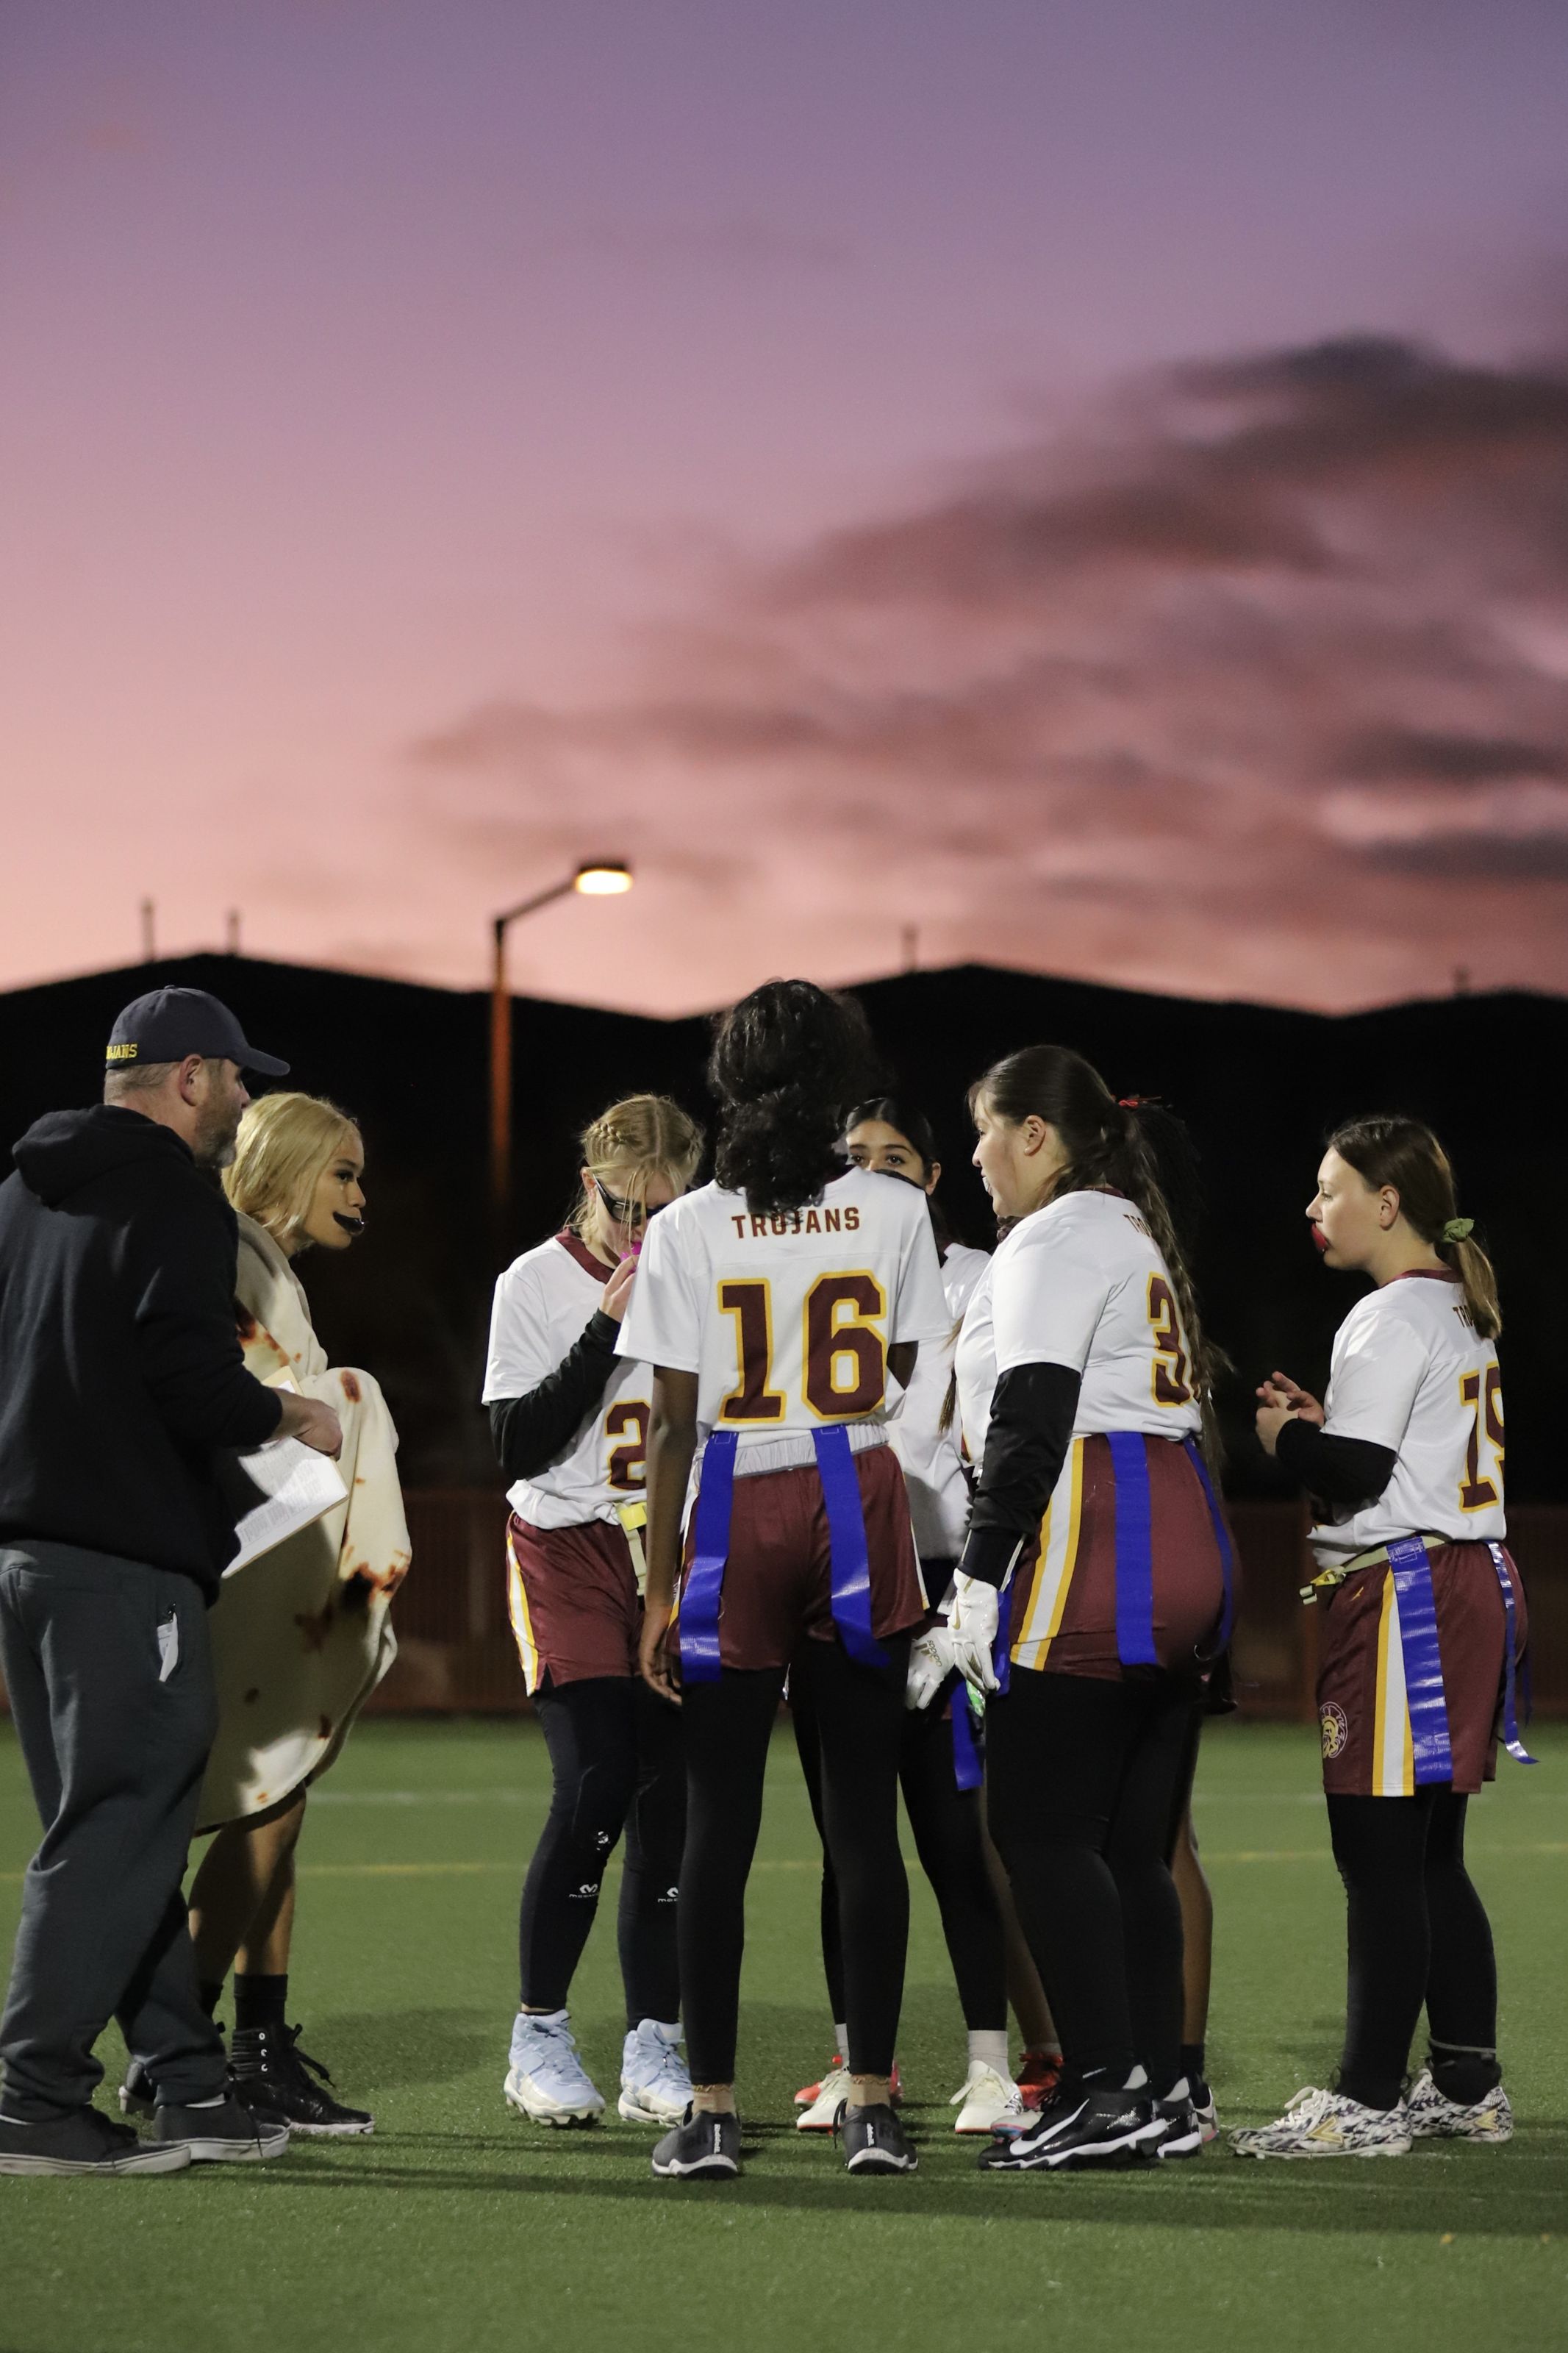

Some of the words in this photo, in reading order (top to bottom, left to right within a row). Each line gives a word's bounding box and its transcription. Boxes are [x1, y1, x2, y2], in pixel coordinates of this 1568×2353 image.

[731, 1207, 860, 1239] TROJANS
[717, 1269, 888, 1424] 16
[1146, 1271, 1201, 1409] 3
[926, 1640, 942, 1668] adidas
